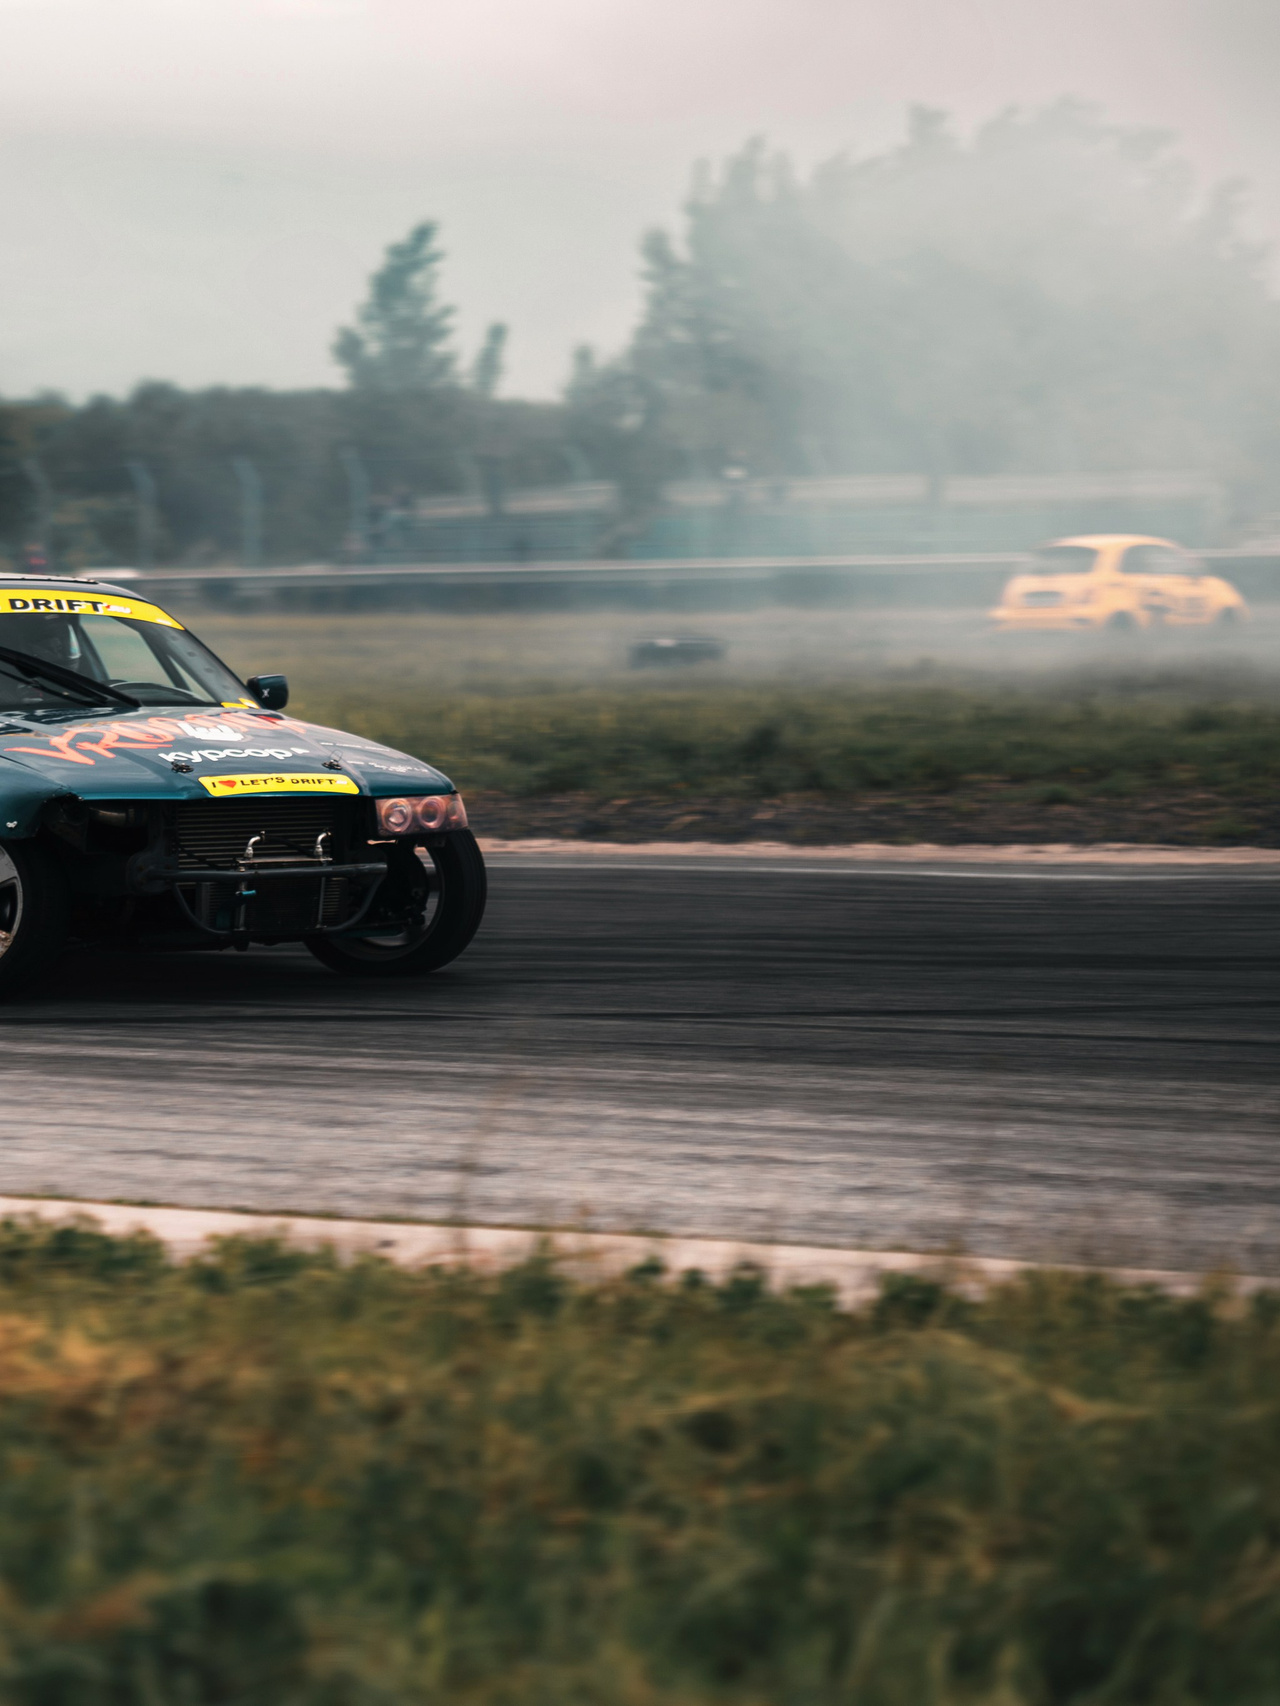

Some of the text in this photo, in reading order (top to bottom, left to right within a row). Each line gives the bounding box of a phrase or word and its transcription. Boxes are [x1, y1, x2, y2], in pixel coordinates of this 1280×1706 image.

[9, 598, 107, 613] DRIFT
[240, 777, 285, 787] LET'S
[290, 777, 335, 786] DRIFT
